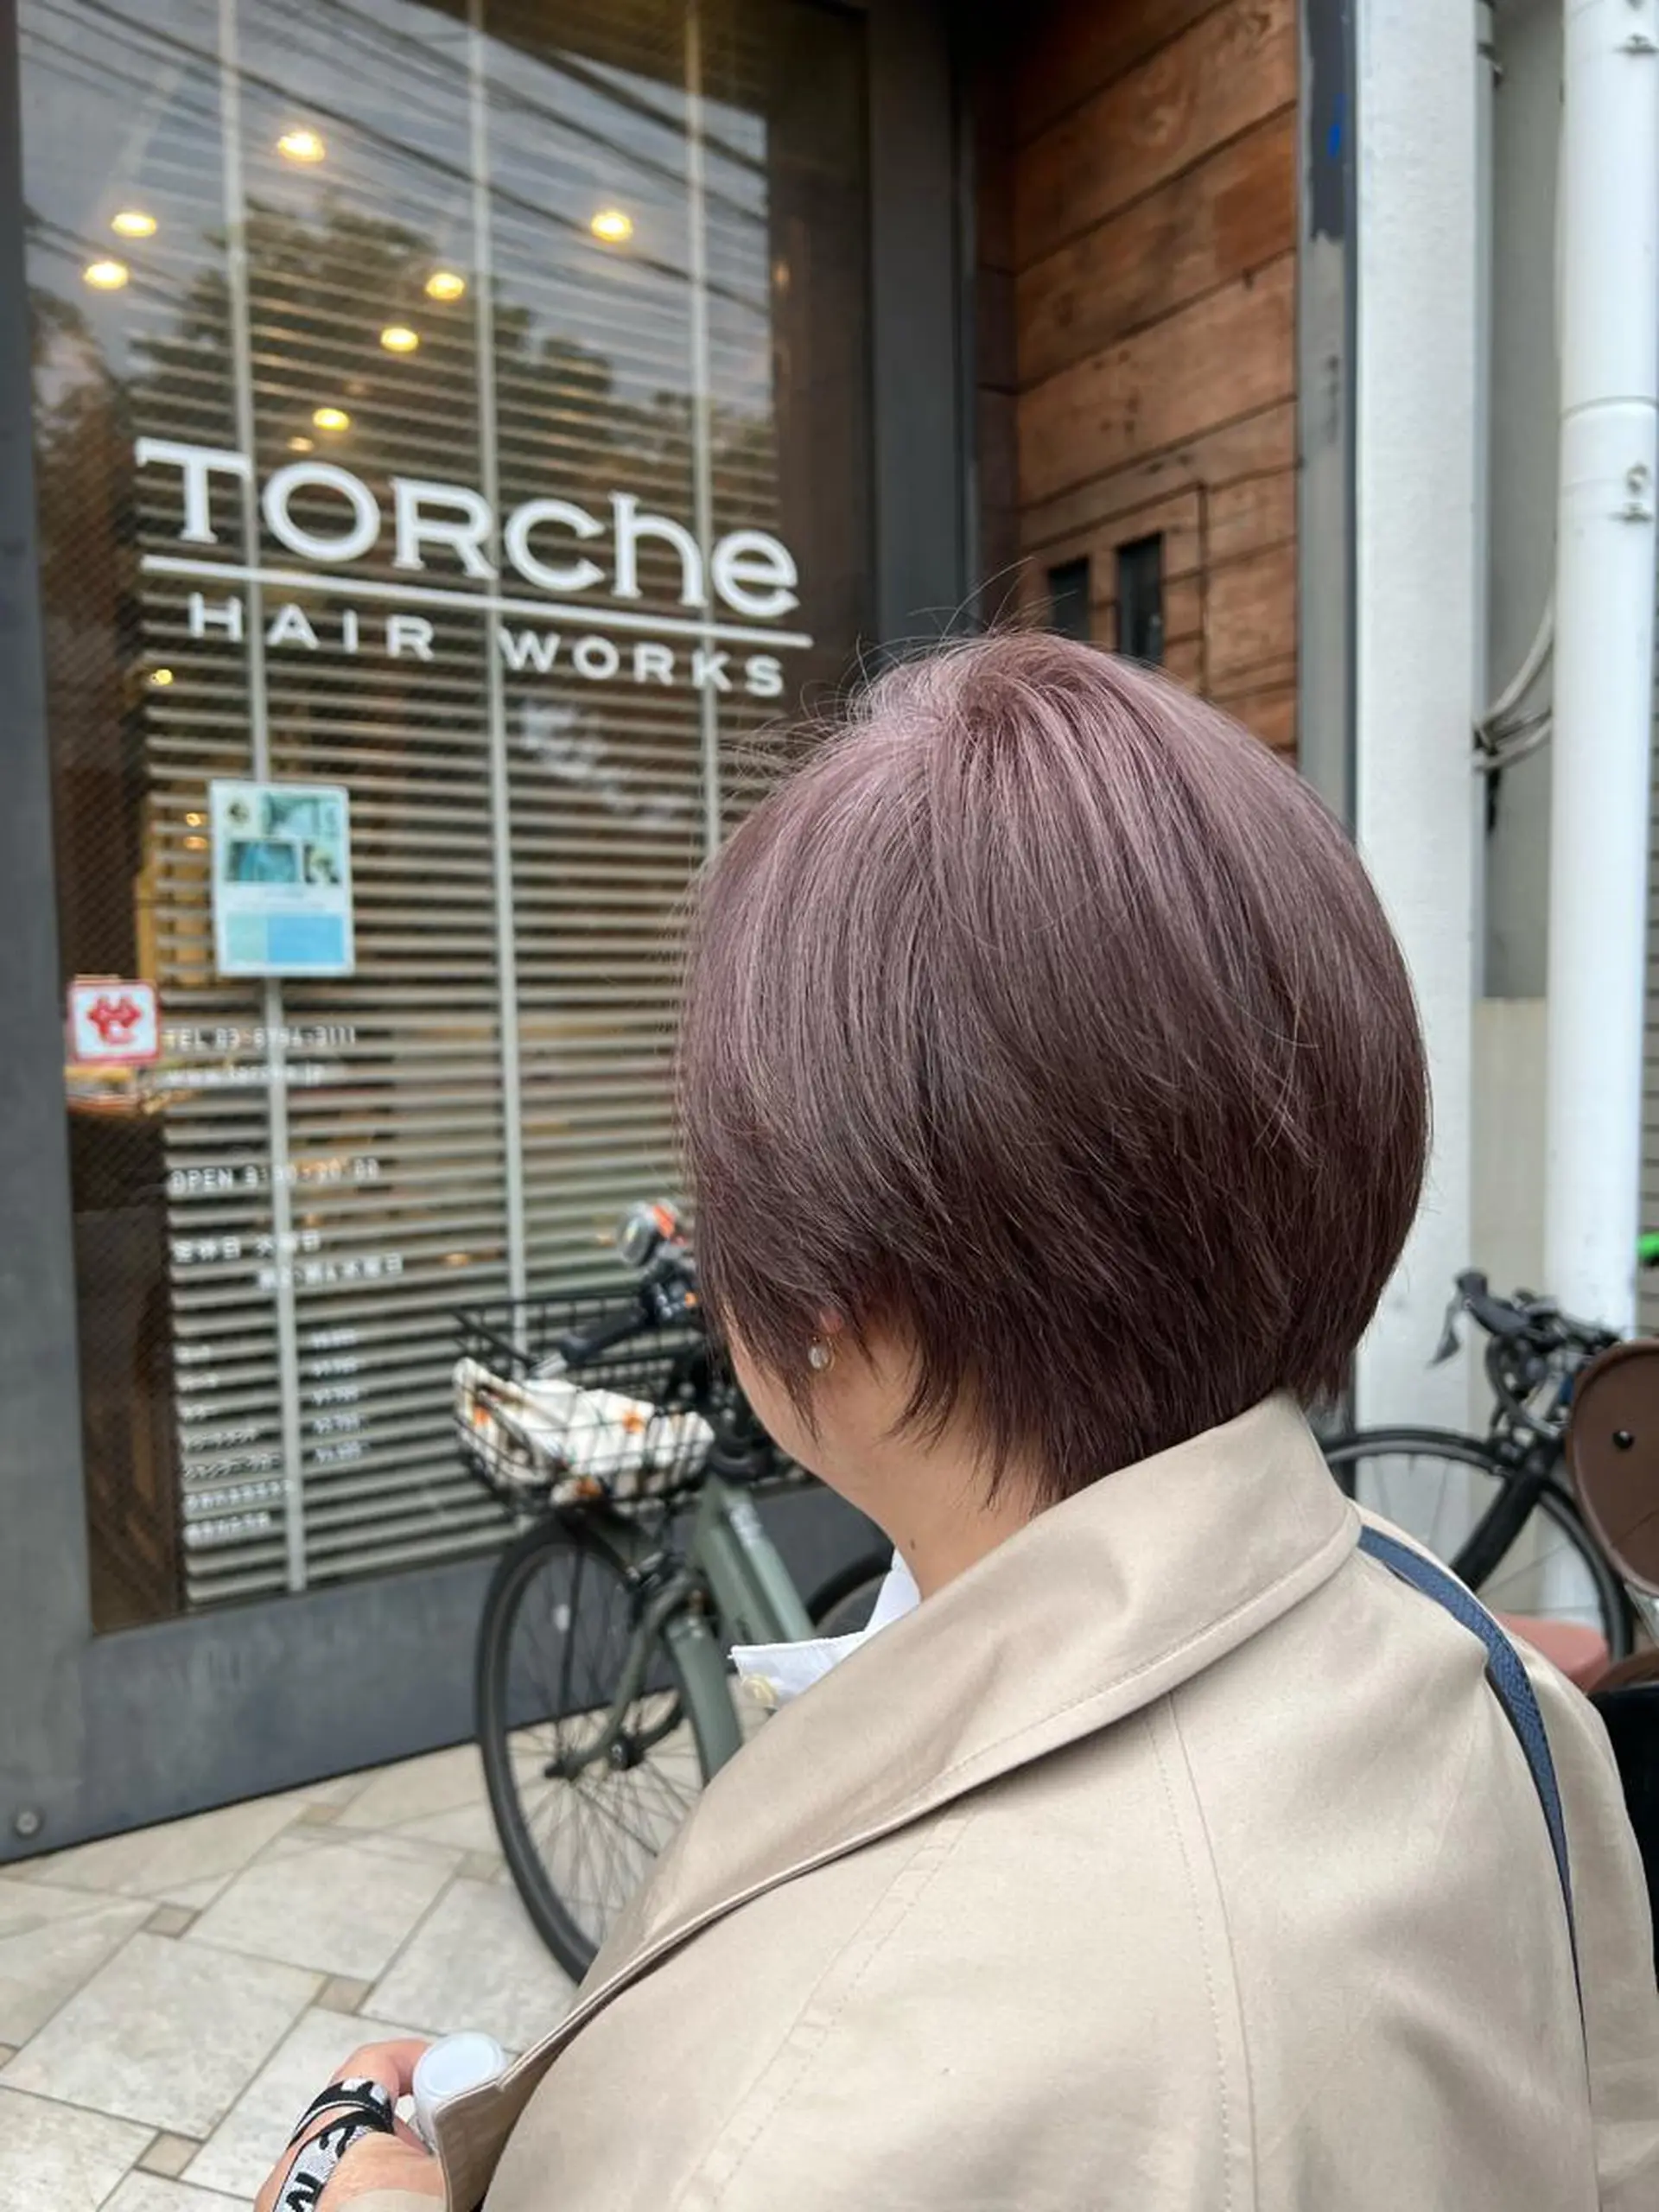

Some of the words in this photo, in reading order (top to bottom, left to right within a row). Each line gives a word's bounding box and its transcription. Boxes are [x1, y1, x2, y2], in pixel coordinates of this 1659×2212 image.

[135, 436, 800, 618] TORche
[188, 592, 435, 662] HAIR
[497, 625, 785, 697] WORKS
[162, 1027, 206, 1052] TEL
[170, 1166, 234, 1192] OPEN
